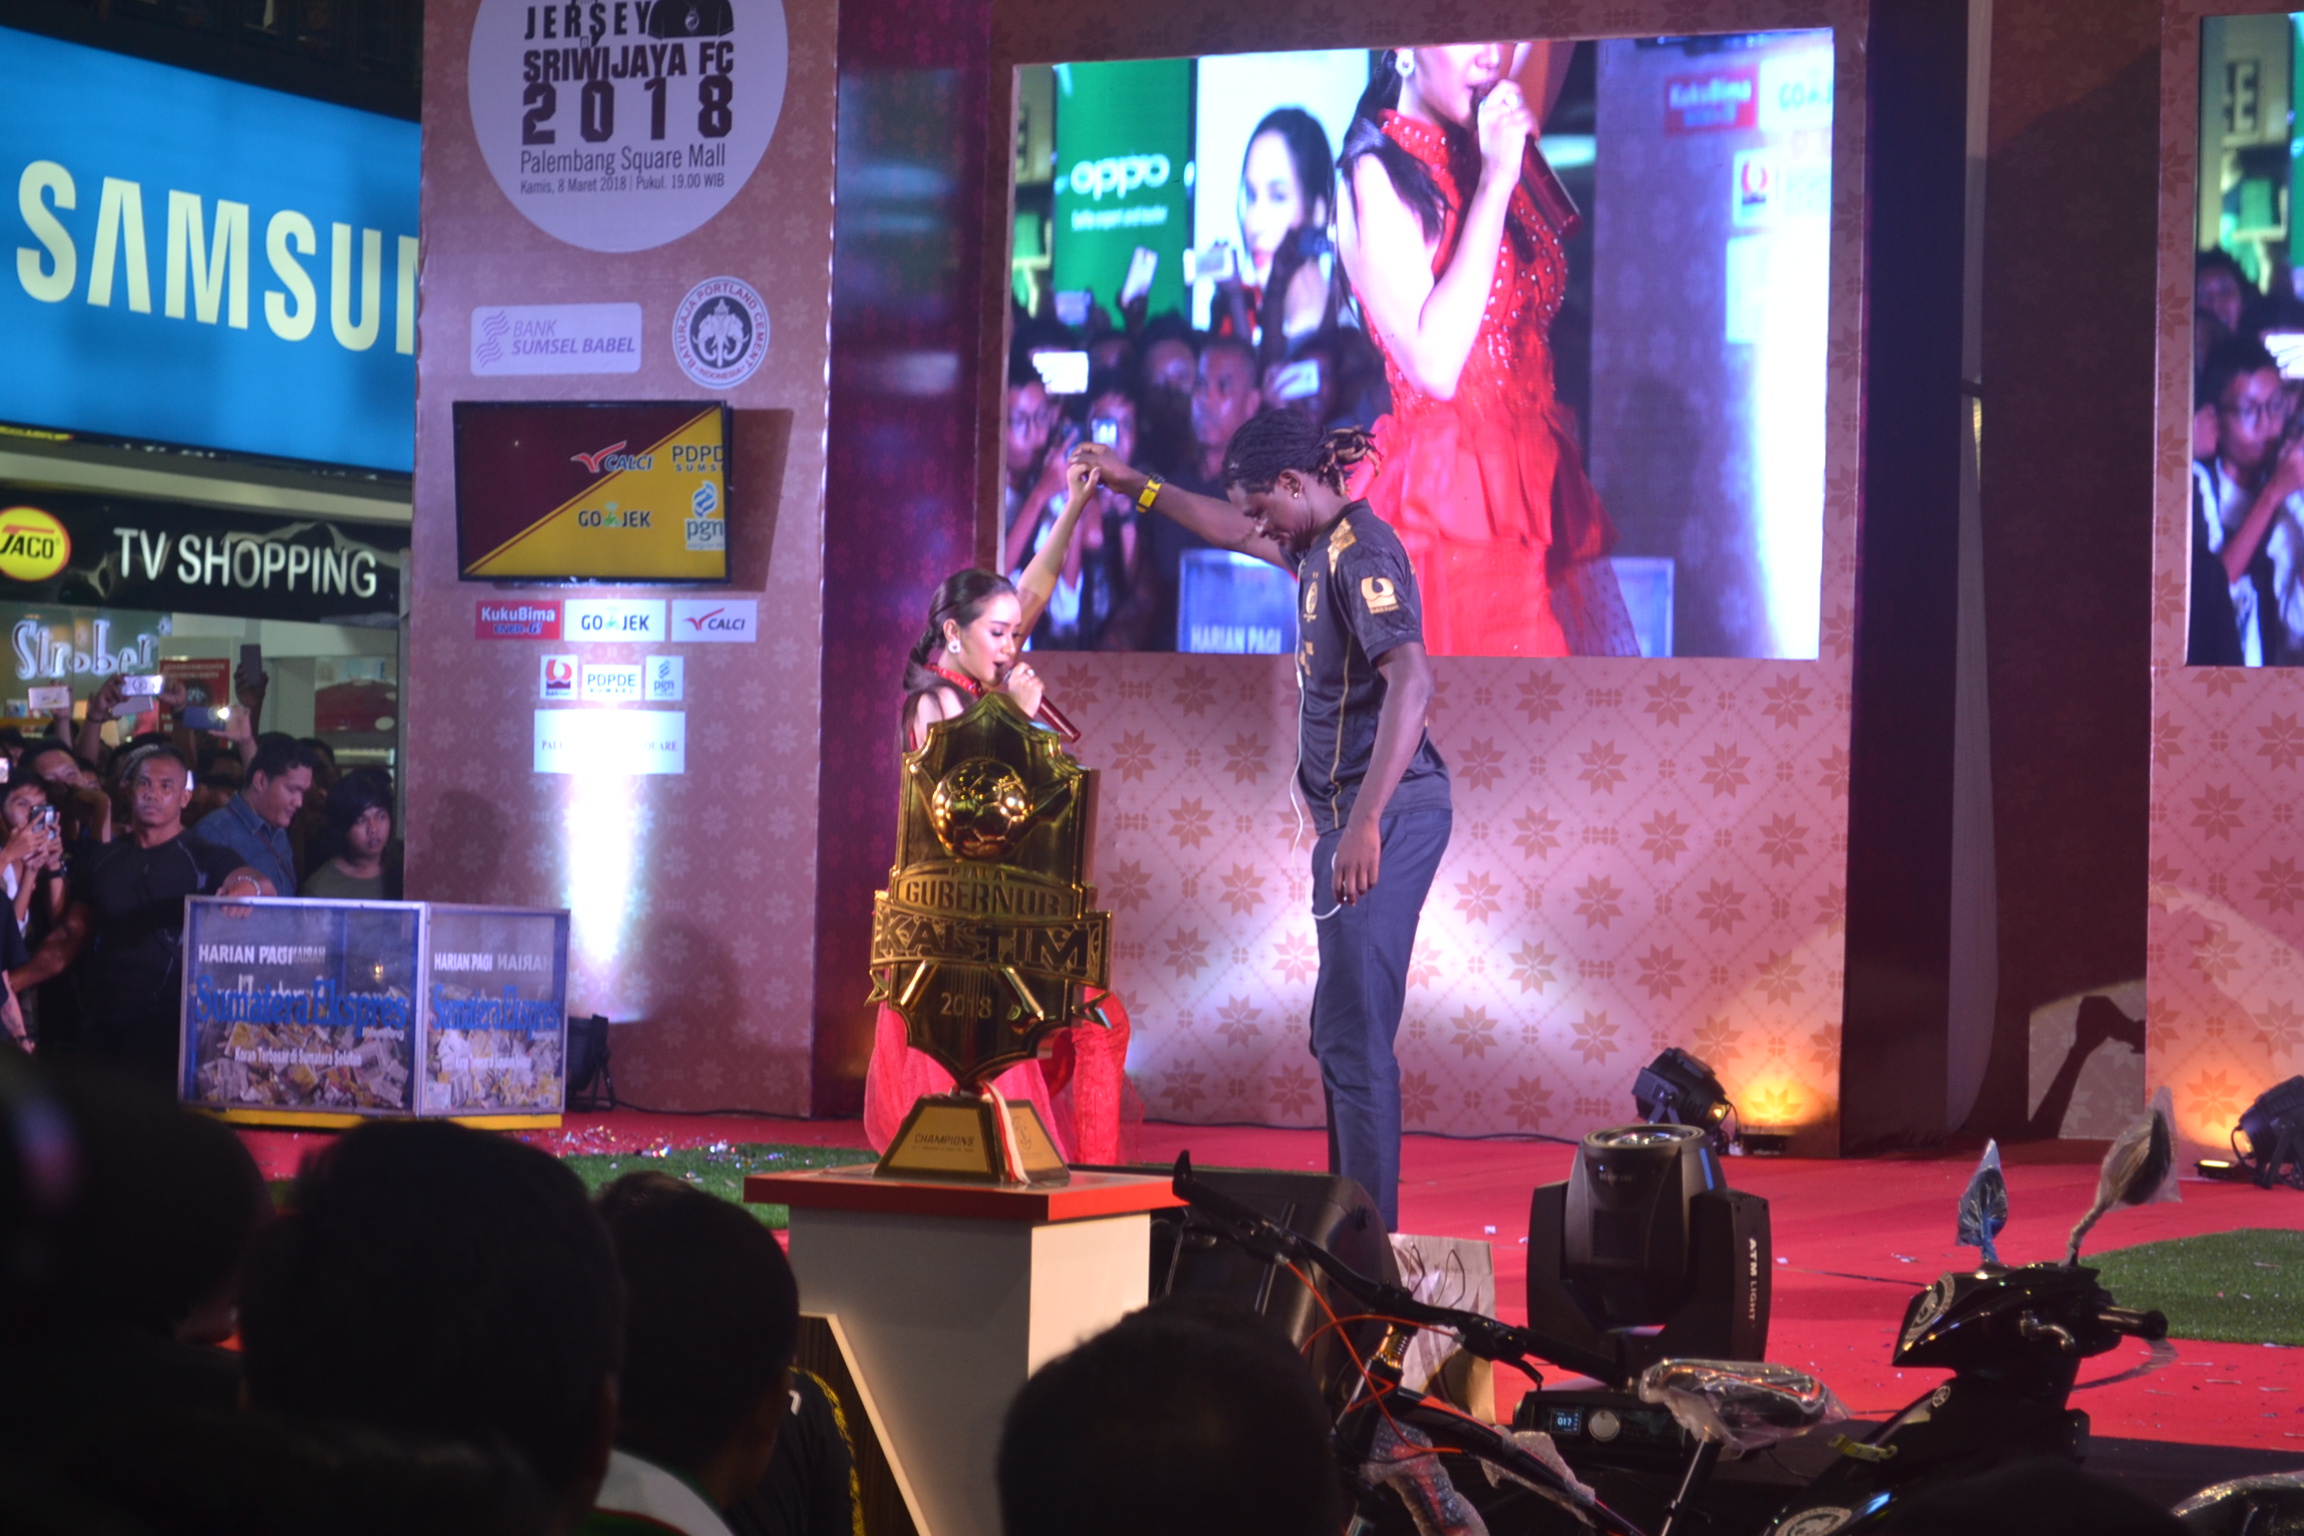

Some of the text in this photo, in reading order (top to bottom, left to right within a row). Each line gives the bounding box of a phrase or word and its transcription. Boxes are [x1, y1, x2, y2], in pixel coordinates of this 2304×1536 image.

[524, 1, 651, 40] JERSEY
[524, 41, 734, 82] SRIWIJAYA FC
[522, 74, 733, 145] 2018
[520, 143, 726, 175] Palembang Square Mall
[521, 172, 725, 195] Kamis, 8 Maret 2018 Pukul. 19.00 WIB
[17, 160, 419, 356] SAMSU
[513, 319, 557, 337] BANK
[678, 283, 765, 369] BATURAJA PORTLAND CEMENT
[512, 337, 636, 355] SUMSEL BABEL
[604, 454, 653, 471] CALCI
[676, 464, 723, 473] SUMS
[0, 525, 55, 559] JACO
[687, 521, 723, 541] pgn
[114, 528, 377, 598] TV SHOPPING
[481, 604, 556, 622] KukuBima
[708, 618, 745, 630] CALCI
[588, 674, 636, 687] PDPDE
[906, 881, 1061, 917] GUBERNUR
[199, 945, 293, 965] HARIAN PAGI
[434, 953, 493, 971] HARIAN PAGI
[196, 974, 407, 1037] Sumatera Ekspres
[432, 984, 559, 1040] Sumatera Ekspres
[940, 992, 992, 1018] 2018
[914, 1133, 974, 1147] CHAMPIONS
[1749, 1238, 1757, 1320] ATM LIGHT
[1557, 1417, 1571, 1426] 017
